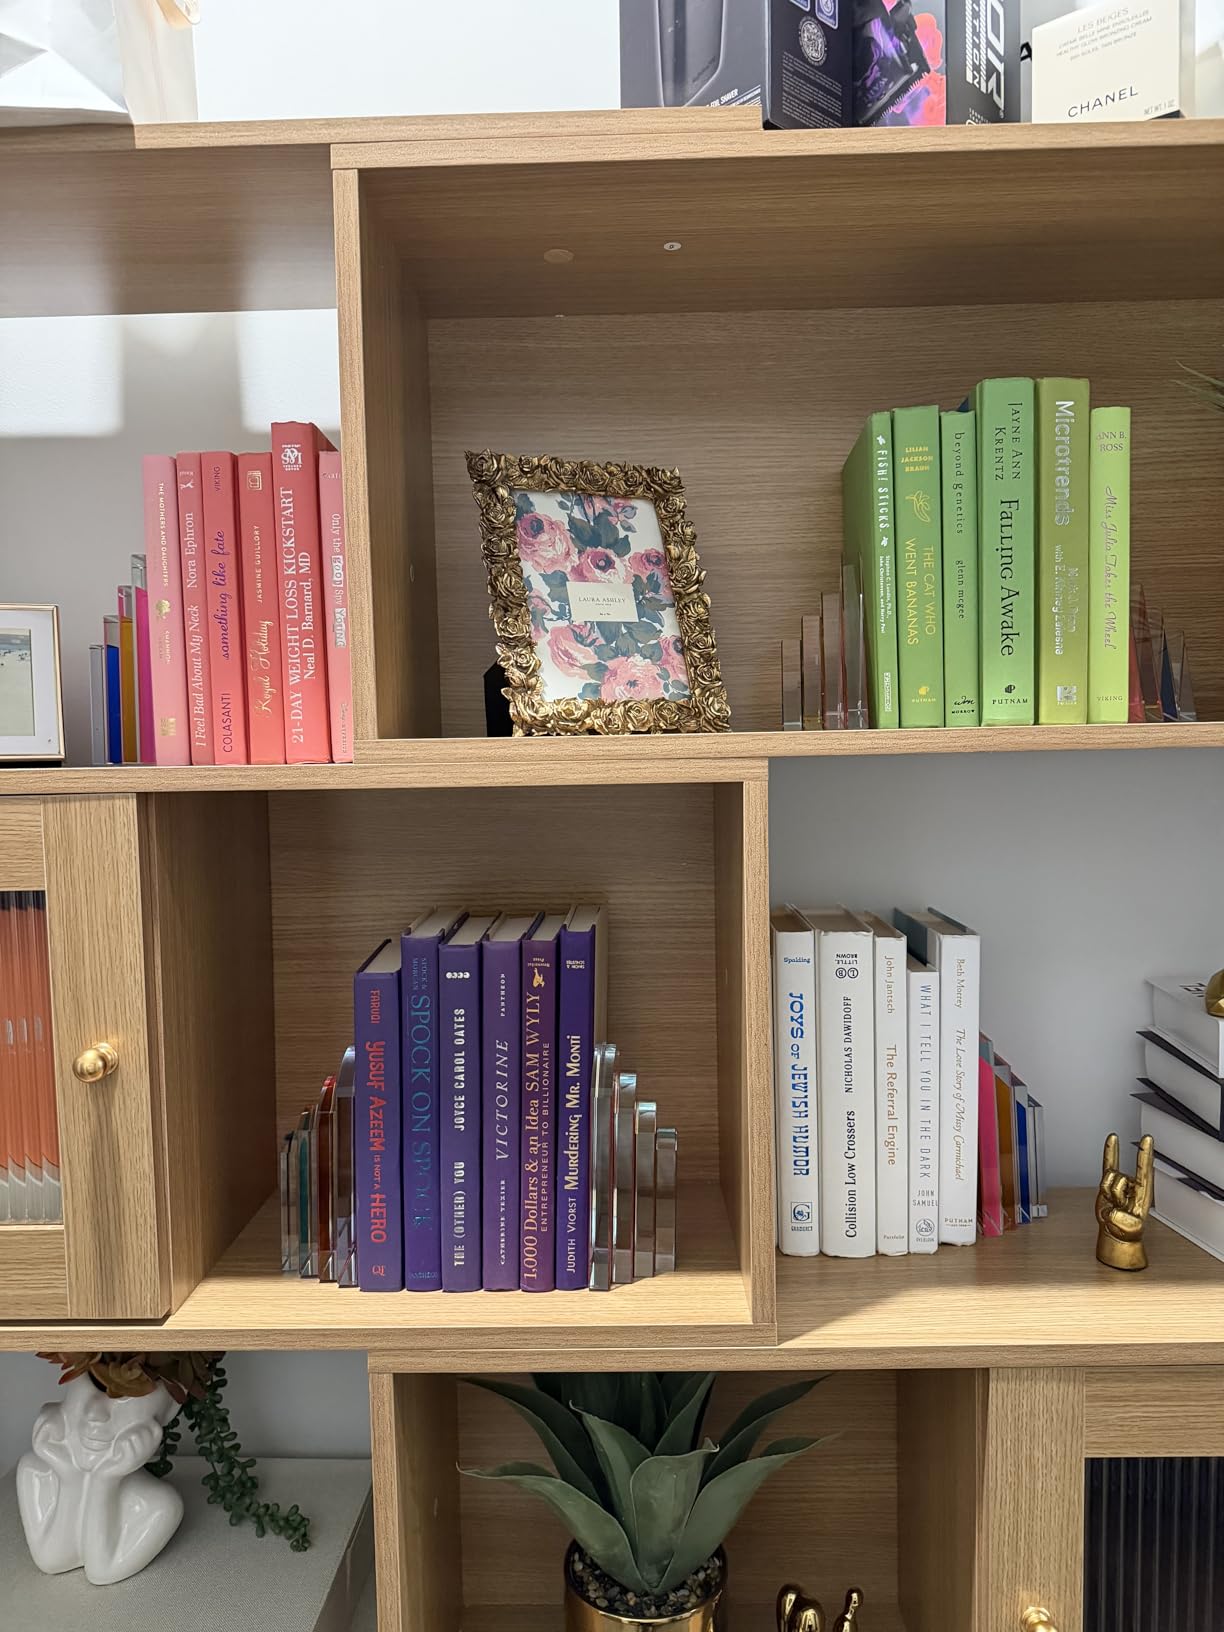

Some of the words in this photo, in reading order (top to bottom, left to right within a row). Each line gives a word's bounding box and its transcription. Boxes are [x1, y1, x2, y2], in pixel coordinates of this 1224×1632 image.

[1068, 86, 1139, 118] CHANEL
[1008, 402, 1022, 444] JAYNE
[953, 432, 965, 477] beyond
[994, 427, 1006, 481] KRENTZ
[1055, 400, 1075, 526] Microtrends
[1100, 444, 1124, 452] ROSS
[877, 450, 889, 481] FISH!
[1012, 450, 1023, 480] ANN
[953, 483, 964, 534] genetics
[1105, 486, 1117, 520] Miss
[184, 512, 197, 555] Ephron
[280, 487, 296, 575] KICKSTART
[331, 513, 342, 535] Only
[1101, 521, 1118, 551] Julia
[211, 531, 230, 556] fate
[333, 538, 343, 552] the
[905, 538, 917, 576] WENT
[923, 546, 934, 569] THE
[1054, 545, 1064, 562] with
[187, 560, 198, 588] Nora
[212, 562, 226, 586] like
[300, 552, 310, 573] MD
[956, 560, 965, 586] glenn
[284, 580, 298, 618] LOSS
[334, 589, 345, 606] Spy
[923, 573, 935, 597] CAT
[1104, 592, 1117, 609] the
[188, 605, 199, 632] Neck
[300, 578, 314, 630] Barnard,
[906, 581, 919, 645] BANANAS
[925, 602, 936, 635] WHO
[956, 590, 965, 619] mcgee
[1001, 585, 1020, 656] Awake
[214, 593, 232, 660] something
[302, 635, 314, 648] D.
[1104, 612, 1117, 649] Wheel
[190, 634, 203, 654] My
[250, 620, 274, 671] Holiday
[286, 624, 301, 684] WEIGHT
[193, 659, 204, 690] About
[304, 653, 316, 680] Neal
[195, 692, 205, 714] Bad
[254, 676, 276, 716] Royal
[196, 718, 206, 739] Feel
[221, 693, 233, 752] COLASANTI
[290, 692, 303, 743] 21-DAY
[885, 956, 894, 977] John
[956, 959, 965, 977] Beth
[370, 989, 380, 1024] FARUQI
[885, 980, 895, 1014] Jantsch
[920, 985, 931, 1016] WHAT
[954, 979, 965, 1008] Morrey
[454, 1008, 465, 1045] OATES
[526, 992, 540, 1045] WYLY
[789, 992, 804, 1039] JOYS
[843, 996, 852, 1043] DAWIDOFF
[410, 995, 431, 1083] SPOCK
[790, 1043, 800, 1059] OF
[920, 1036, 931, 1062] TELL
[956, 1029, 966, 1045] The
[365, 1041, 385, 1091] YUSUF
[454, 1051, 465, 1089] CAROL
[525, 1052, 540, 1091] SAM
[844, 1047, 853, 1093] NICHOLAS
[886, 1044, 897, 1068] The
[956, 1048, 965, 1068] Love
[791, 1064, 809, 1119] JEWISH
[886, 1072, 898, 1120] Referral
[920, 1070, 931, 1092] YOU
[953, 1070, 965, 1091] Story
[411, 1091, 431, 1132] ON
[454, 1095, 465, 1131] JOYCE
[495, 1040, 508, 1160] VICTORINE
[920, 1100, 931, 1111] IN
[953, 1093, 965, 1102] of
[369, 1096, 386, 1151] AZEEM
[525, 1100, 540, 1130] Idea
[542, 1122, 548, 1136] TO
[920, 1120, 931, 1140] THE
[953, 1103, 965, 1132] Missy
[792, 1125, 810, 1176] HUMOR
[844, 1110, 856, 1159] Crossers
[884, 1125, 898, 1165] Engine
[454, 1162, 465, 1184] YOU
[525, 1159, 538, 1172] &
[845, 1163, 856, 1185] Low
[920, 1149, 931, 1179] DARK
[953, 1135, 965, 1180] Carmichael
[369, 1194, 386, 1243] HERO
[453, 1190, 466, 1238] (OTHER)
[524, 1177, 537, 1231] Dollars
[567, 1197, 576, 1233] VIORST
[845, 1190, 857, 1238] Collision
[454, 1245, 465, 1266] THE
[523, 1236, 537, 1279] 1,000
[566, 1238, 576, 1274] JUDITH
